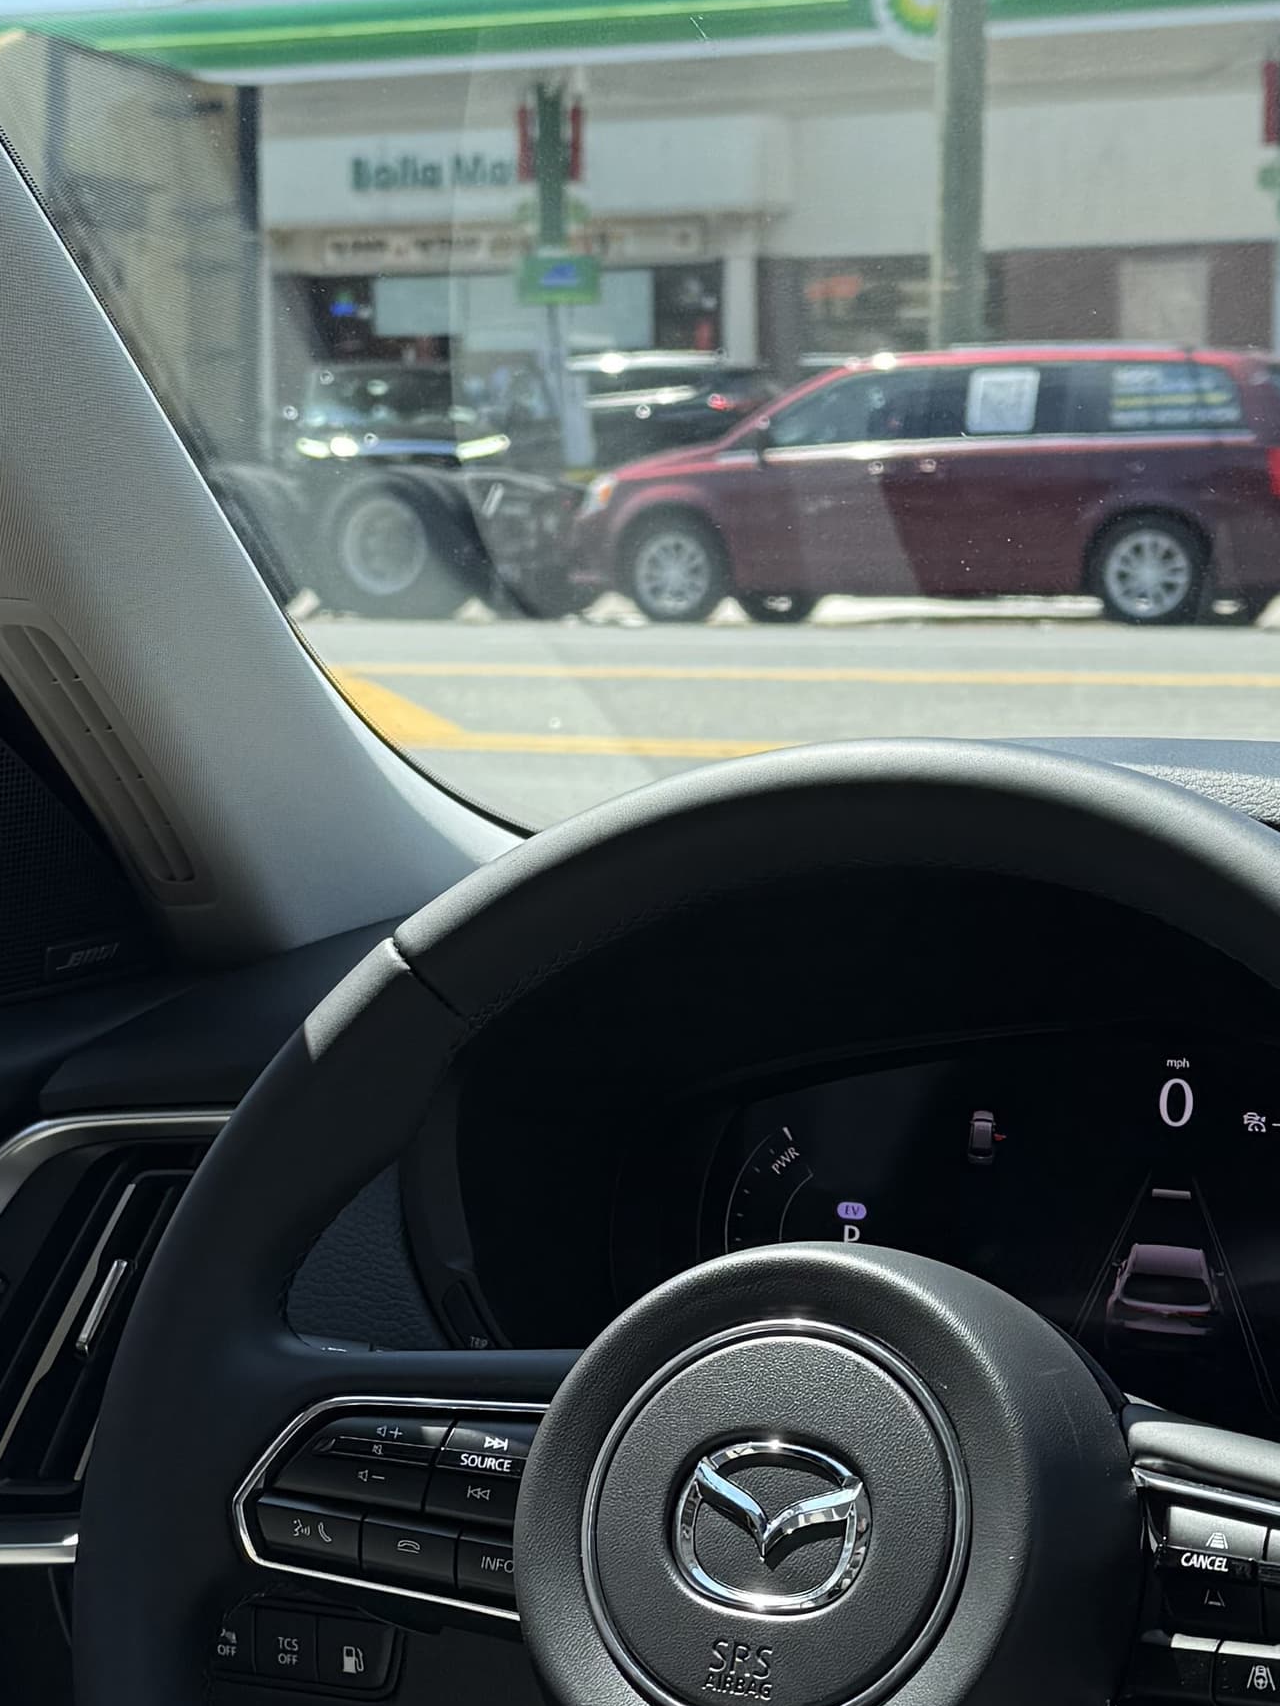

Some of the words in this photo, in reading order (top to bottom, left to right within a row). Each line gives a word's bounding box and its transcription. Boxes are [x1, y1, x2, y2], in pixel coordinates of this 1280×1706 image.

[1166, 1058, 1190, 1069] mph
[1159, 1078, 1193, 1127] 0
[771, 1147, 801, 1175] PWR
[460, 1453, 512, 1472] SOURCE
[1180, 1552, 1229, 1573] CANCEL
[217, 1644, 237, 1657] OFF
[277, 1636, 299, 1652] TCS
[278, 1653, 299, 1666] OFF
[709, 1639, 773, 1680] SRS
[701, 1674, 773, 1701] AIRBAG
